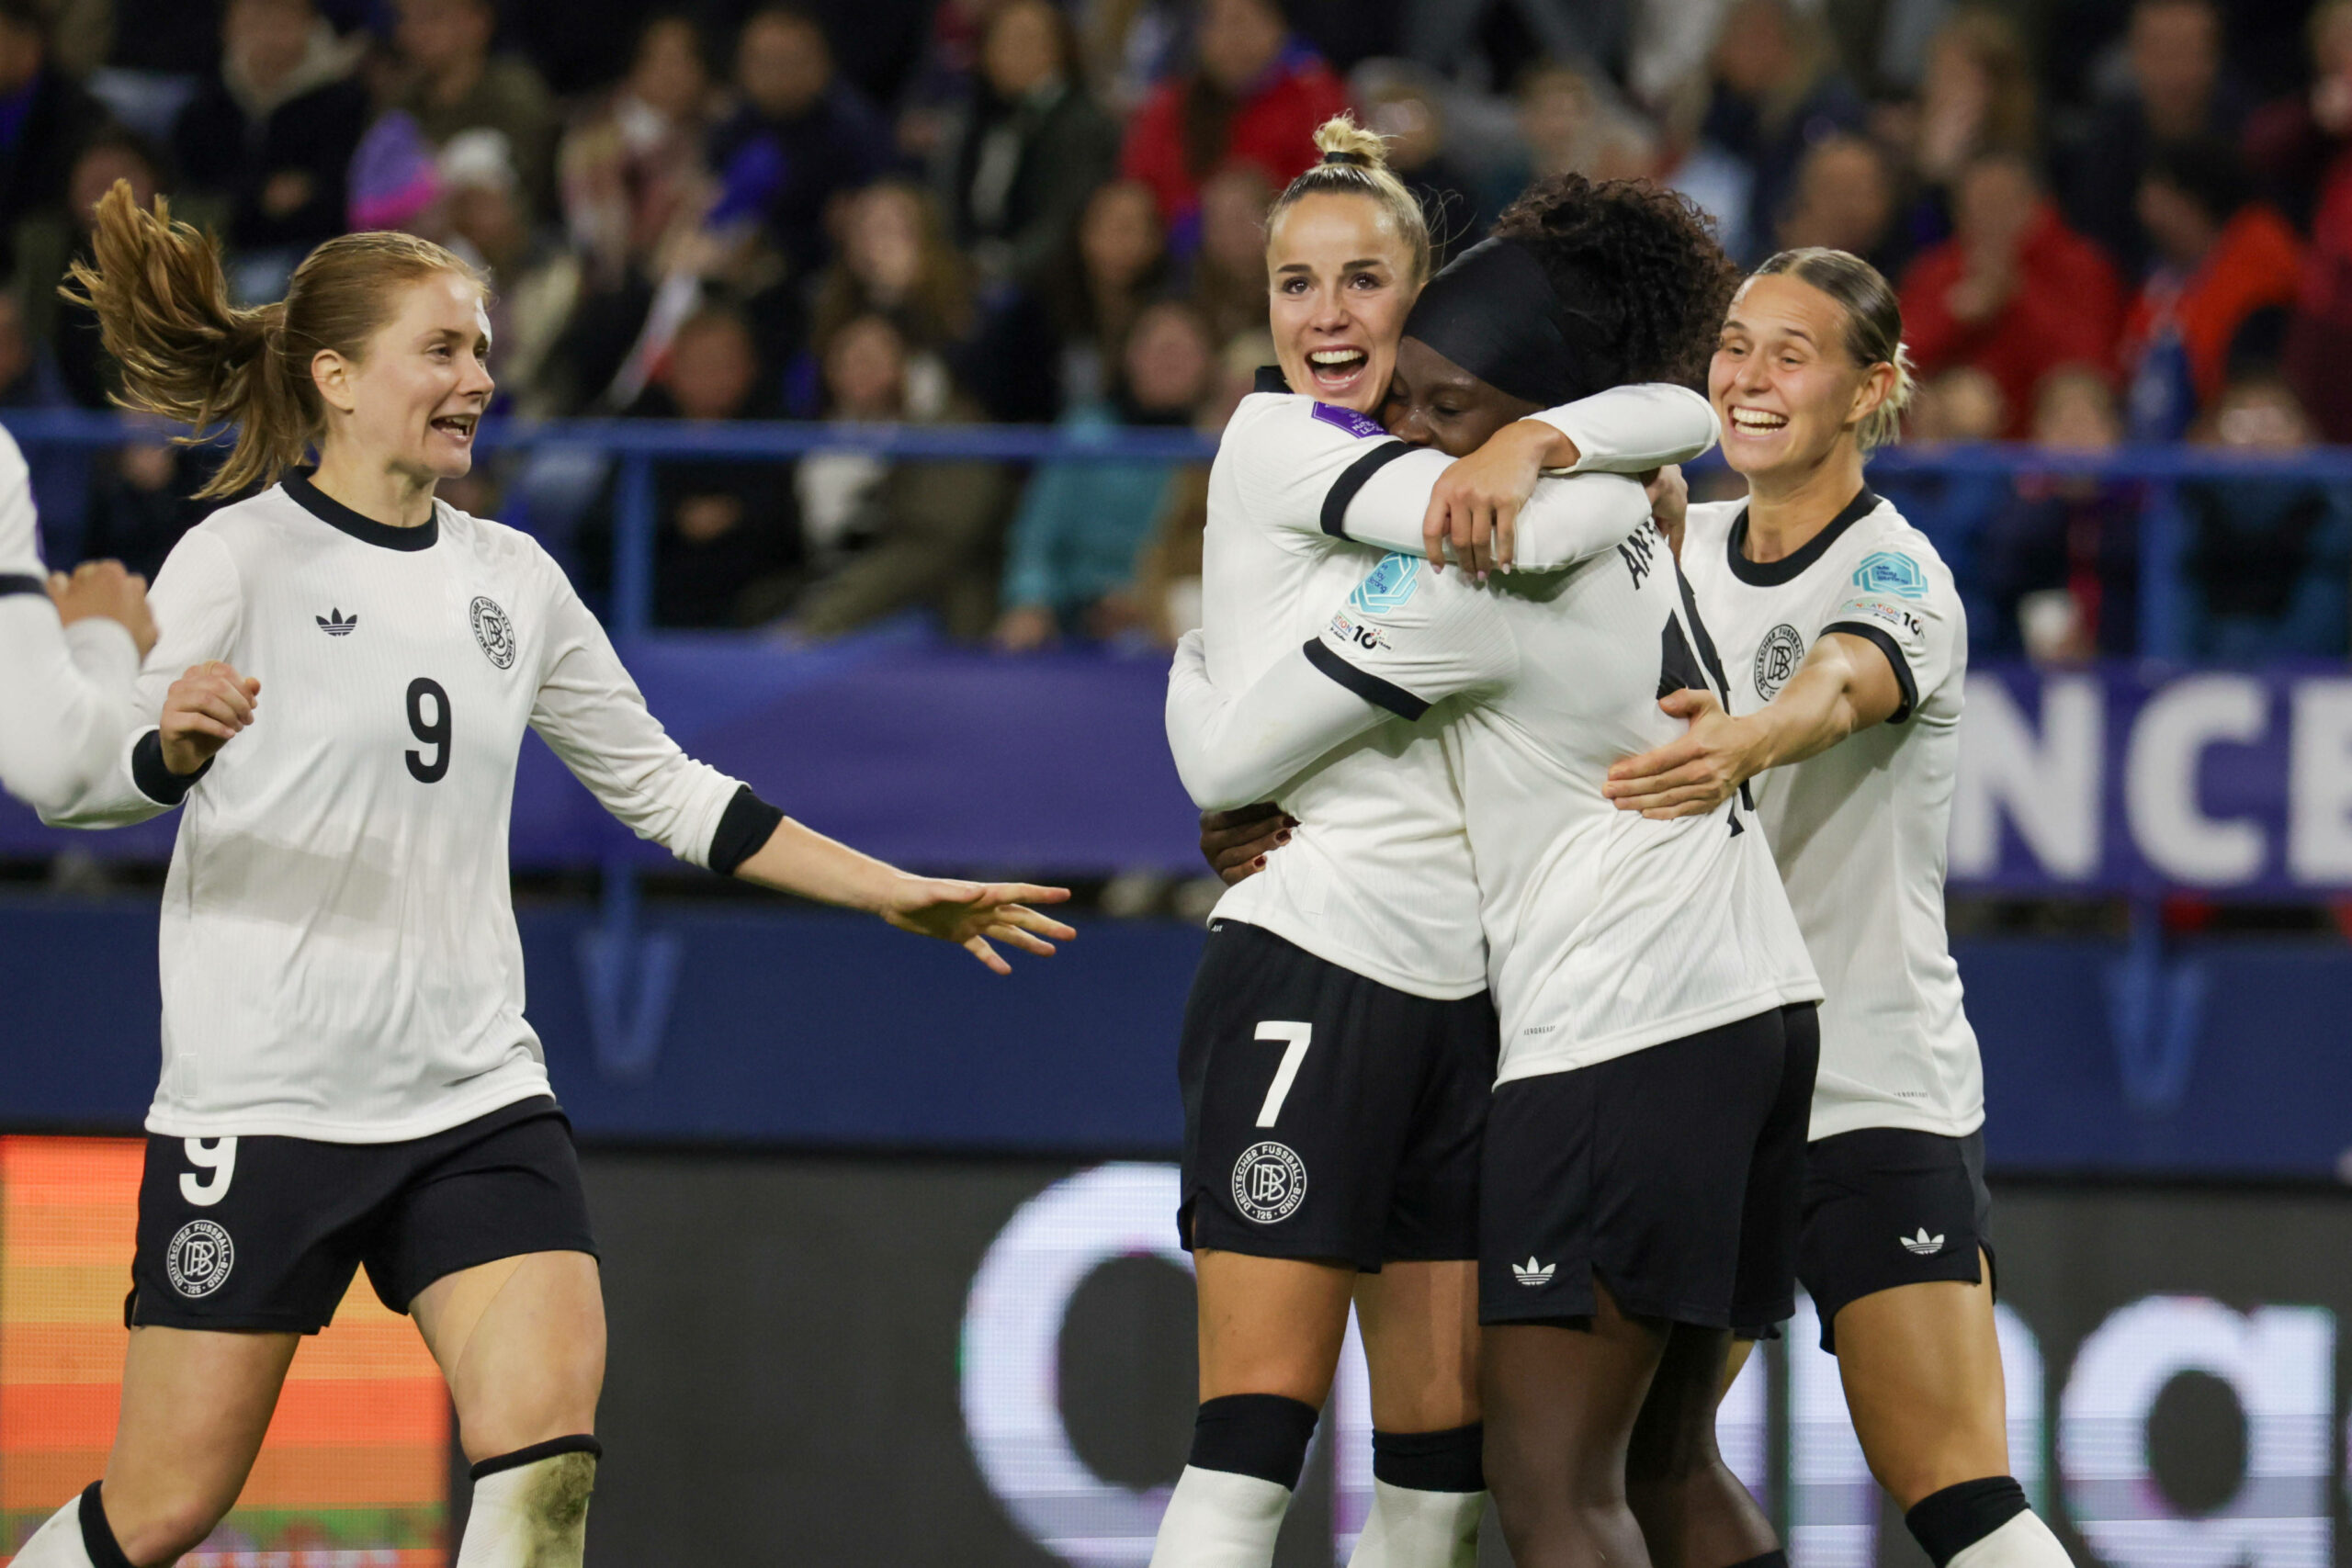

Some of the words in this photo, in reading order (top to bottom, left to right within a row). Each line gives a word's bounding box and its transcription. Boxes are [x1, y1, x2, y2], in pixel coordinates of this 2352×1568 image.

[1353, 625, 1377, 649] 10
[405, 677, 451, 784] 9
[1254, 1021, 1312, 1127] 7
[179, 1136, 238, 1206] 9
[1235, 1148, 1259, 1211] DEUTSCHER
